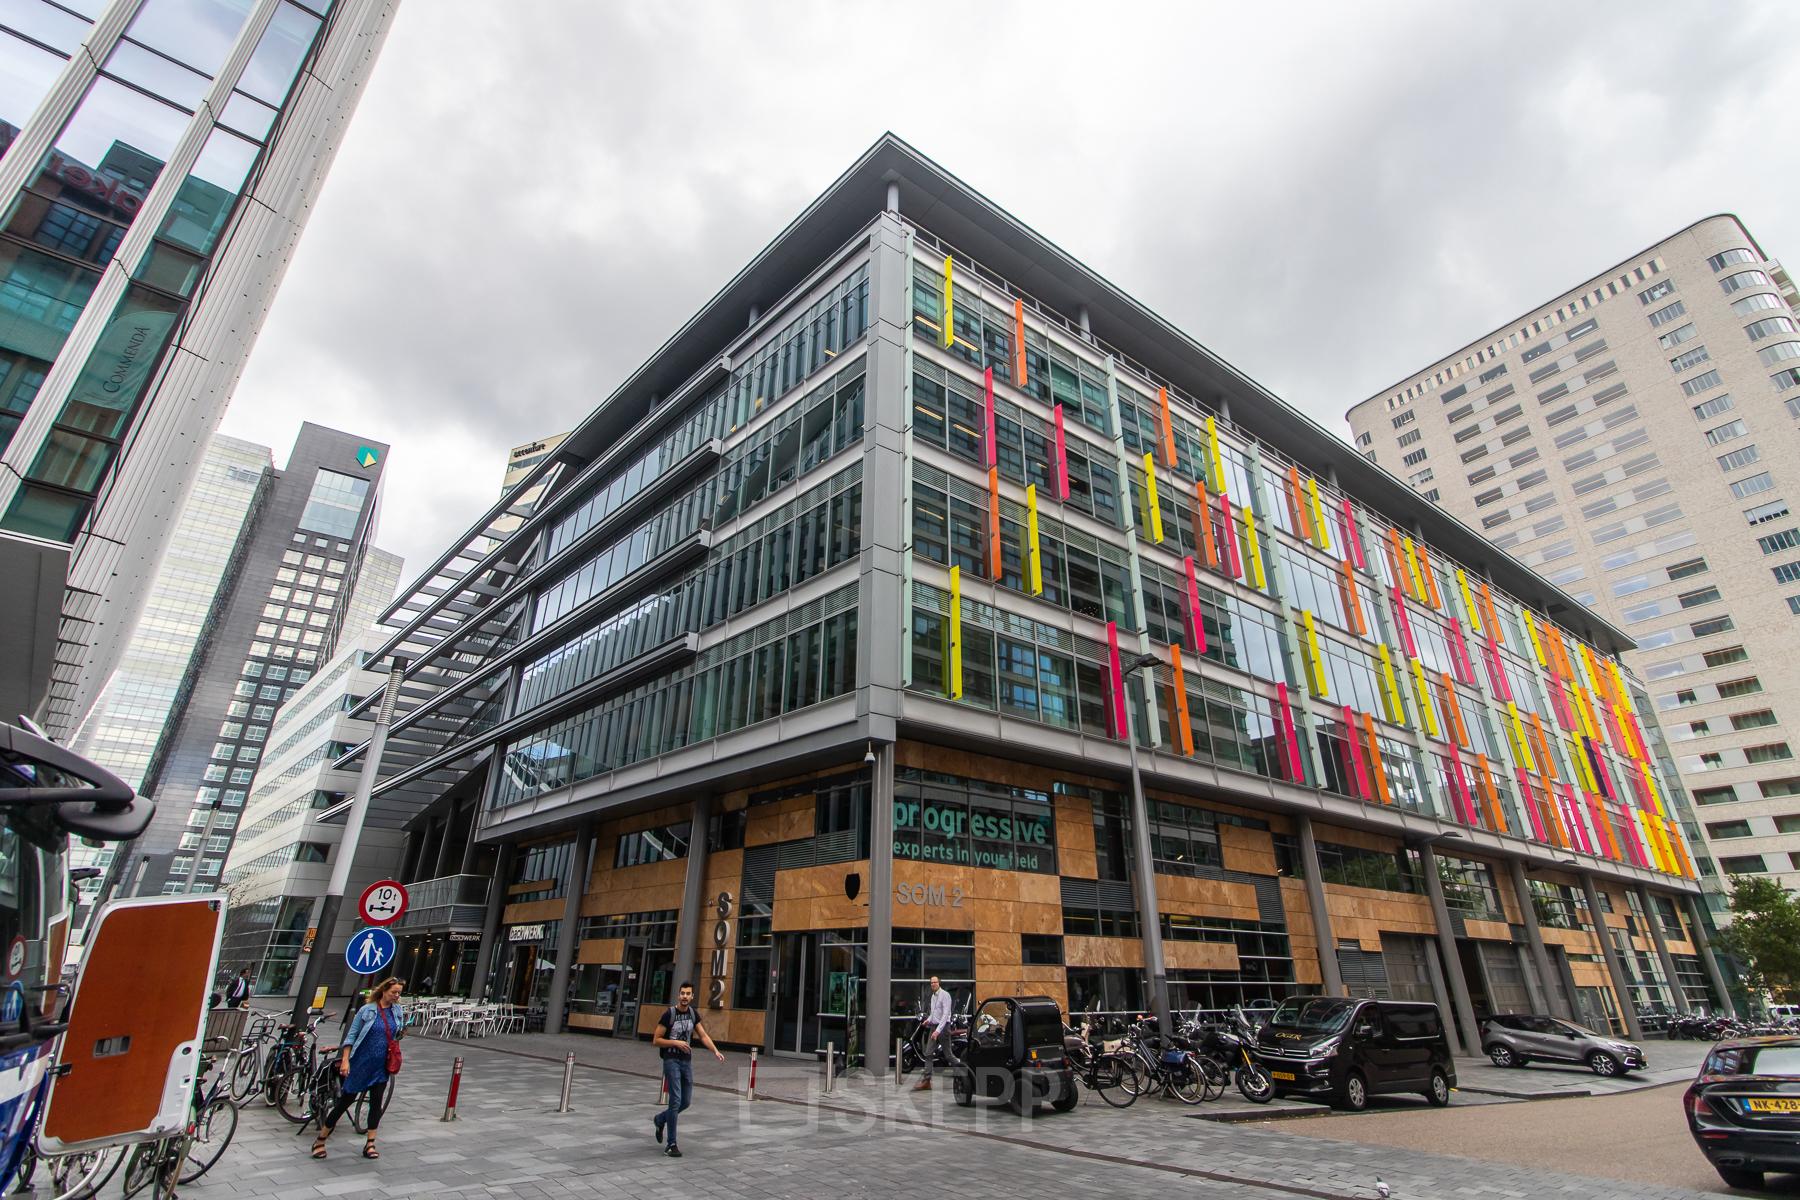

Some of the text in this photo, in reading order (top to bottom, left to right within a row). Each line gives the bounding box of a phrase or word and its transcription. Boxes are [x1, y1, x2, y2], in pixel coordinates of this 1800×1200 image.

[102, 326, 150, 393] COMMENDA
[893, 801, 1046, 844] progressive
[893, 840, 1039, 870] experts in your field
[378, 888, 393, 900] 10
[896, 882, 965, 908] SOM 2
